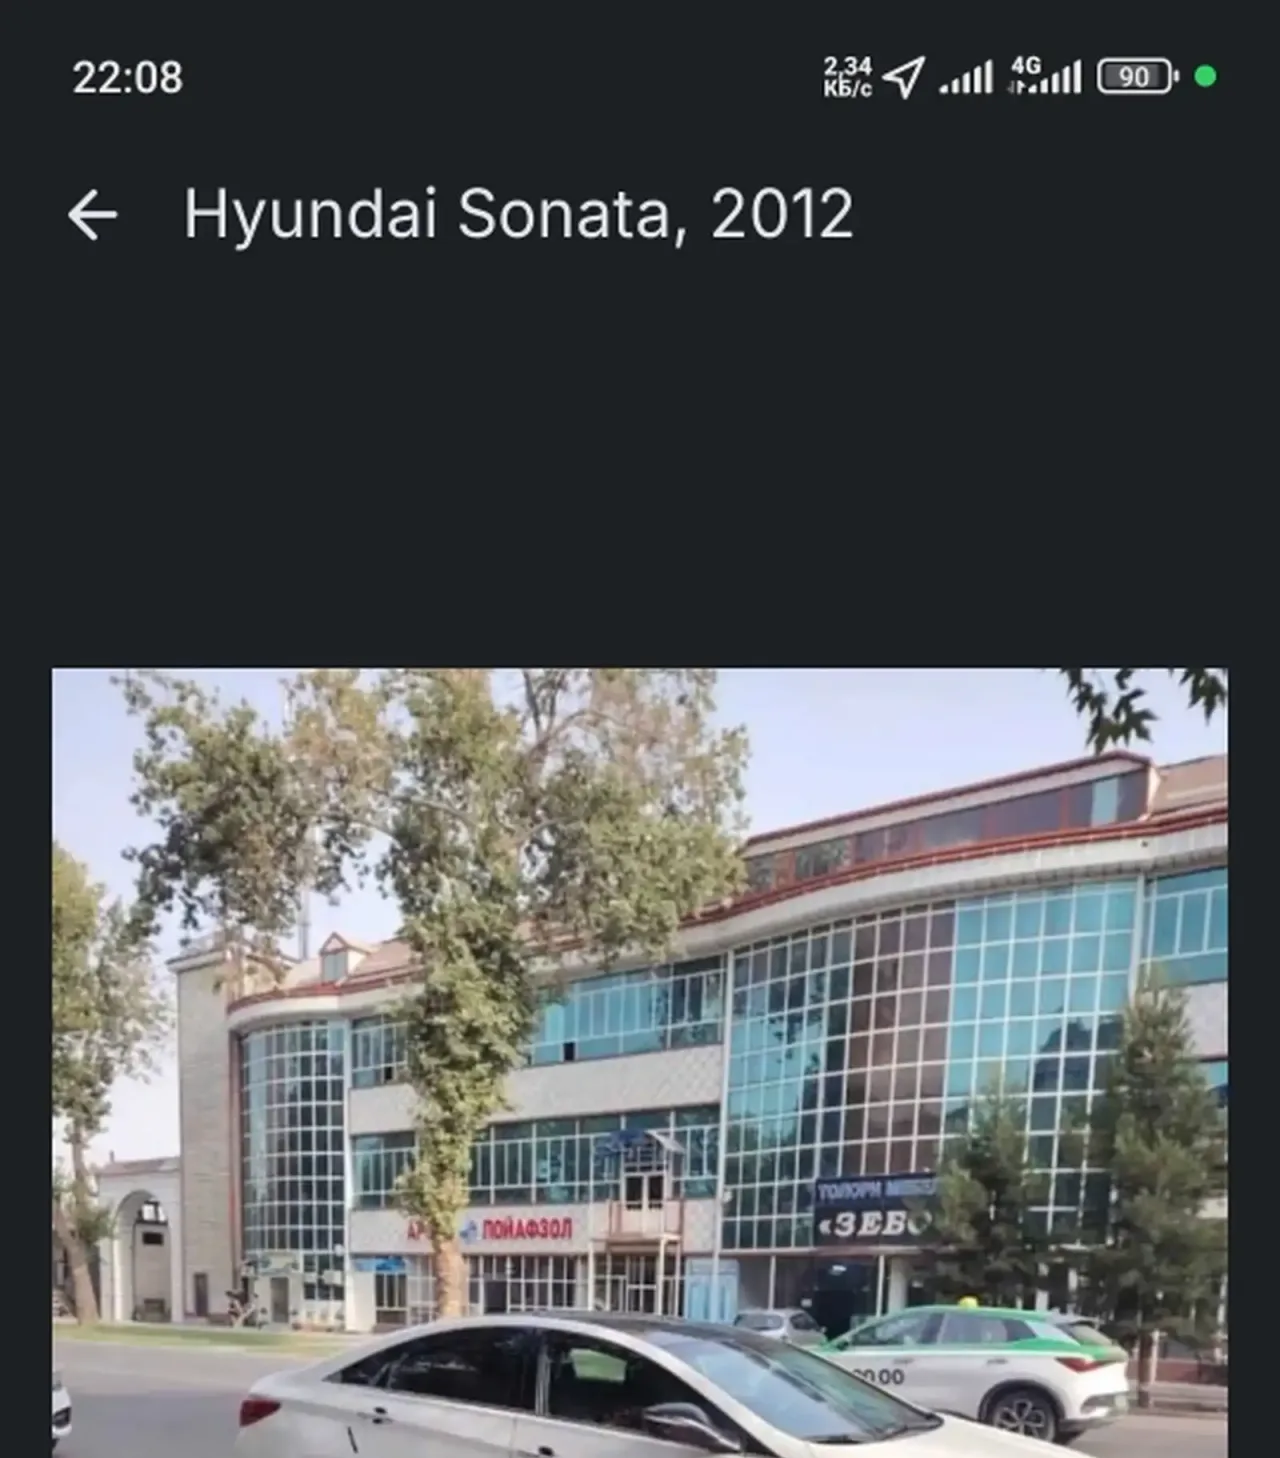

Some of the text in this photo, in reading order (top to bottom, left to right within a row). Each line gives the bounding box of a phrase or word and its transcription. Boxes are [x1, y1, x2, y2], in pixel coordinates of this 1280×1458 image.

[73, 60, 183, 95] 22:08
[824, 56, 873, 79] 2,34
[1012, 56, 1042, 76] 4G
[1119, 66, 1150, 88] 90
[186, 185, 854, 251] Hyundai Sonata, 2012
[483, 1215, 573, 1240] ПОЙАФЗОЛ
